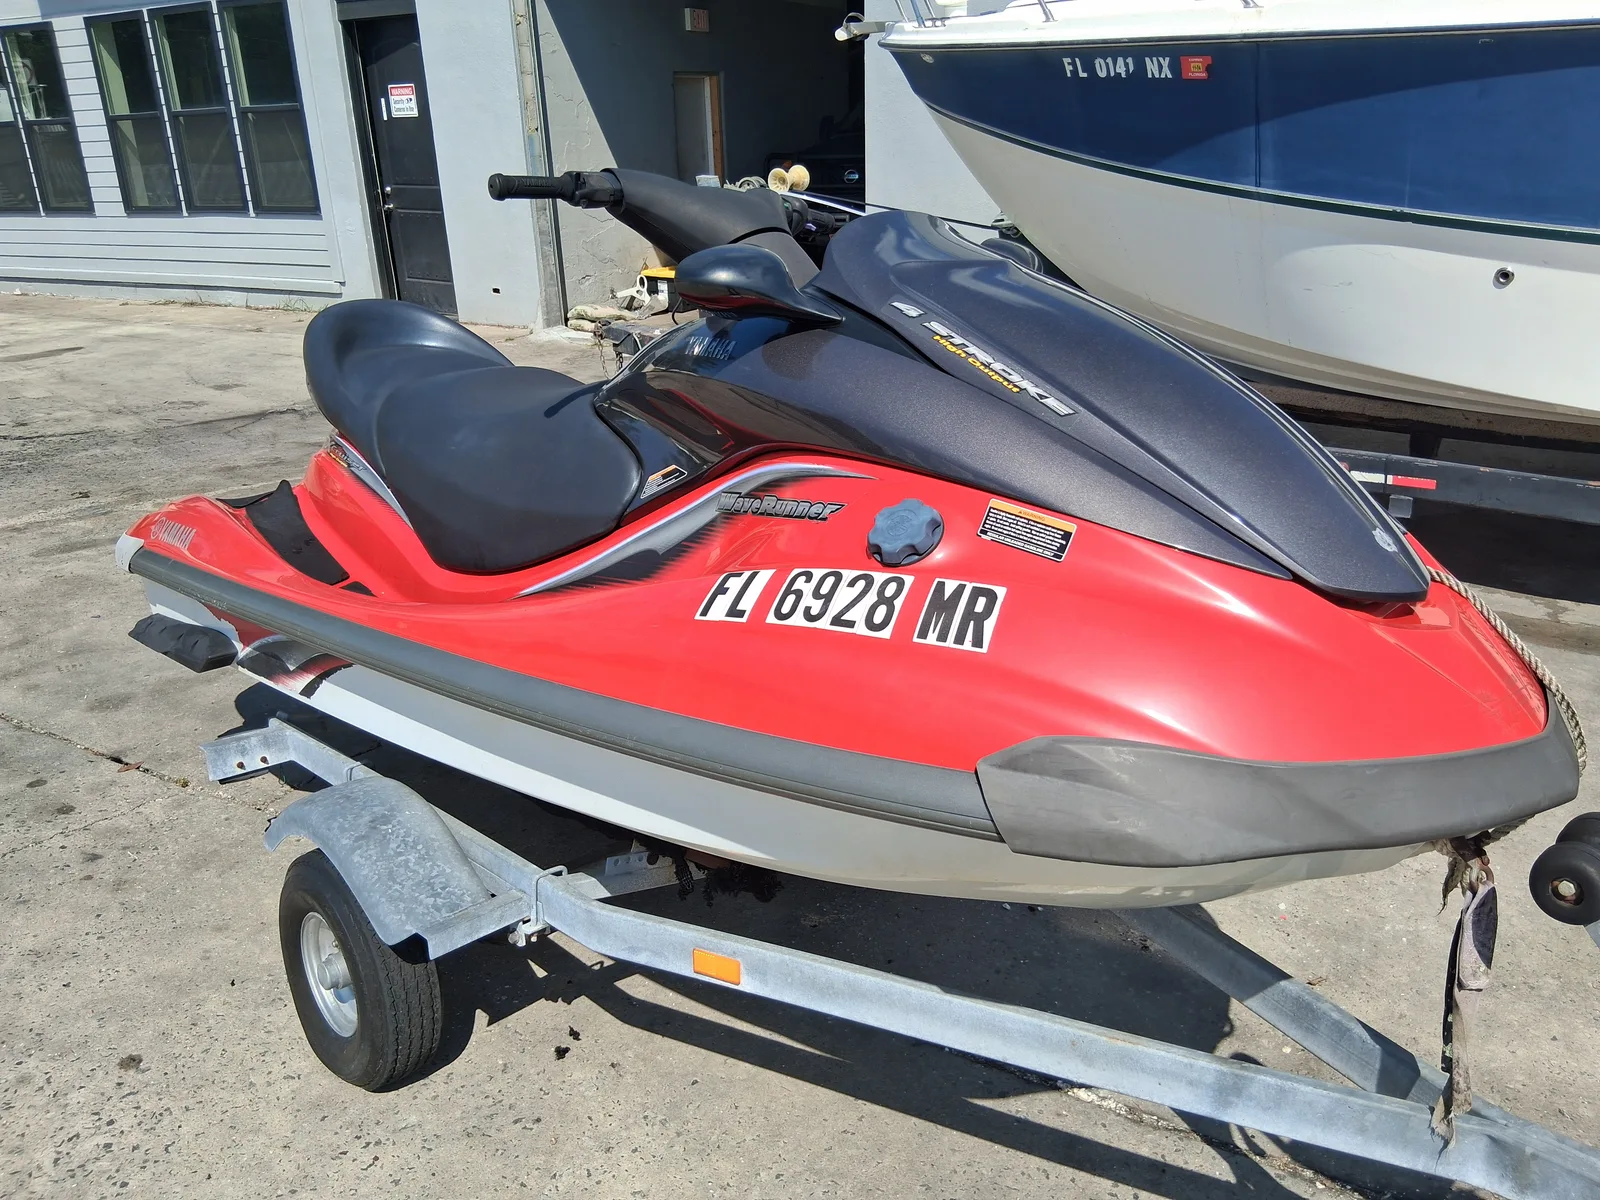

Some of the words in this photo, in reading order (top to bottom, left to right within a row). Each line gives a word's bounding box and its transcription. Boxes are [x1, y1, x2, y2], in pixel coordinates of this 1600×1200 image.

[1062, 57, 1088, 78] FL
[1094, 57, 1135, 78] 0141
[1145, 57, 1173, 78] NX
[391, 87, 412, 95] WARNING
[685, 336, 737, 360] YAMAHA
[889, 301, 926, 318] 4
[921, 321, 1077, 417] STROKE
[932, 335, 967, 359] High
[967, 357, 1022, 394] Output
[717, 491, 847, 522] WaveRunner
[1022, 511, 1045, 521] WARNING
[699, 571, 760, 619] FL
[773, 569, 906, 633] 6928
[916, 580, 998, 649] MR
